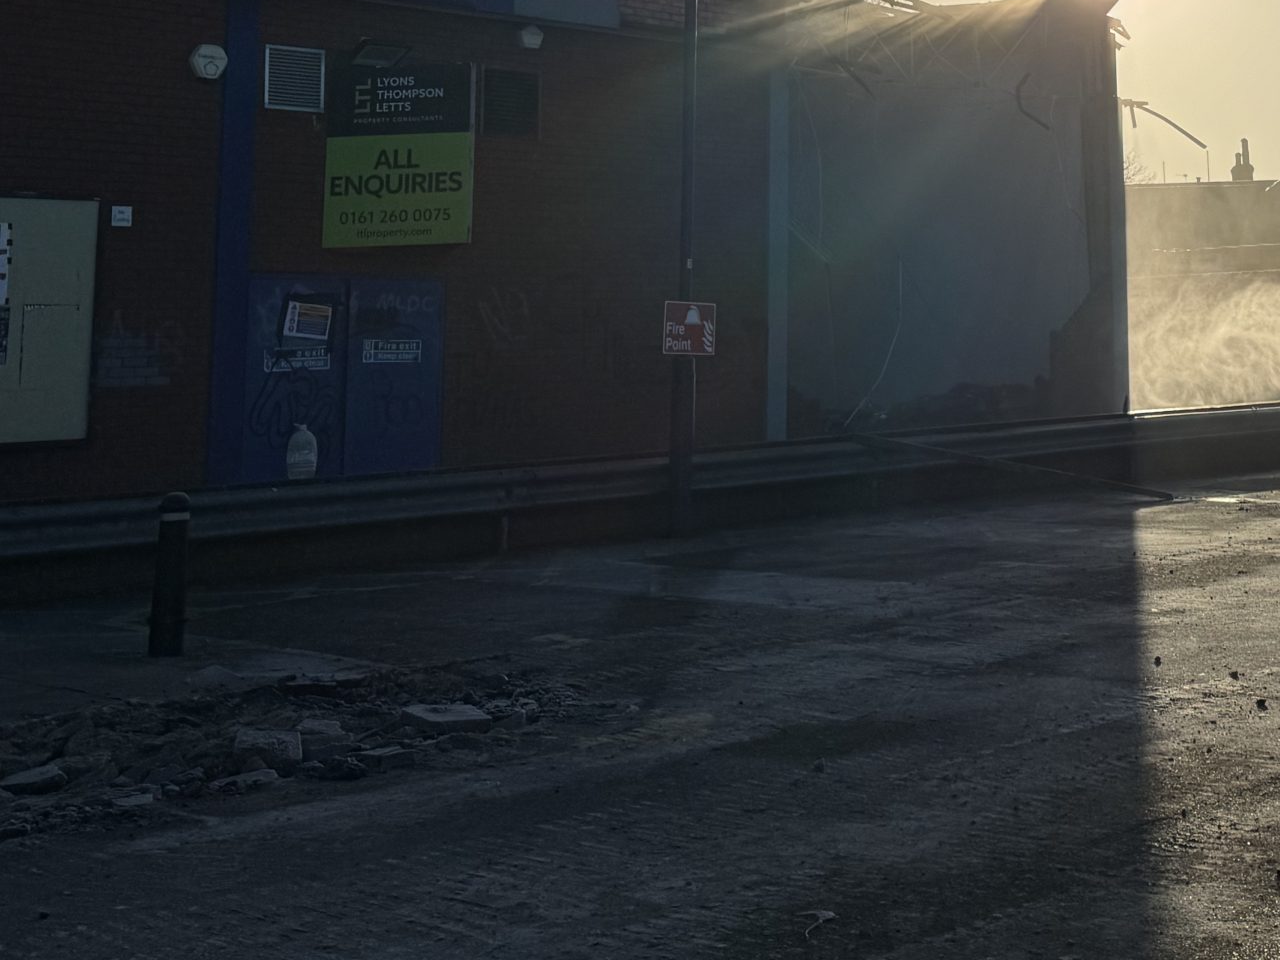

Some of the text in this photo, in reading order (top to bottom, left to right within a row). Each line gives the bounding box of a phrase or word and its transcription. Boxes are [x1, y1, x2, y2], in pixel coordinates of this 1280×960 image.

[377, 76, 415, 87] LYONS
[376, 88, 444, 100] THOMPSON
[376, 102, 411, 113] LETTS
[373, 148, 419, 170] ALL
[330, 171, 462, 198] ENQUIRIES
[339, 208, 451, 225] 0161 260 0075
[666, 322, 686, 335] Fire
[378, 341, 417, 351] Fire exit
[665, 337, 691, 351] Point
